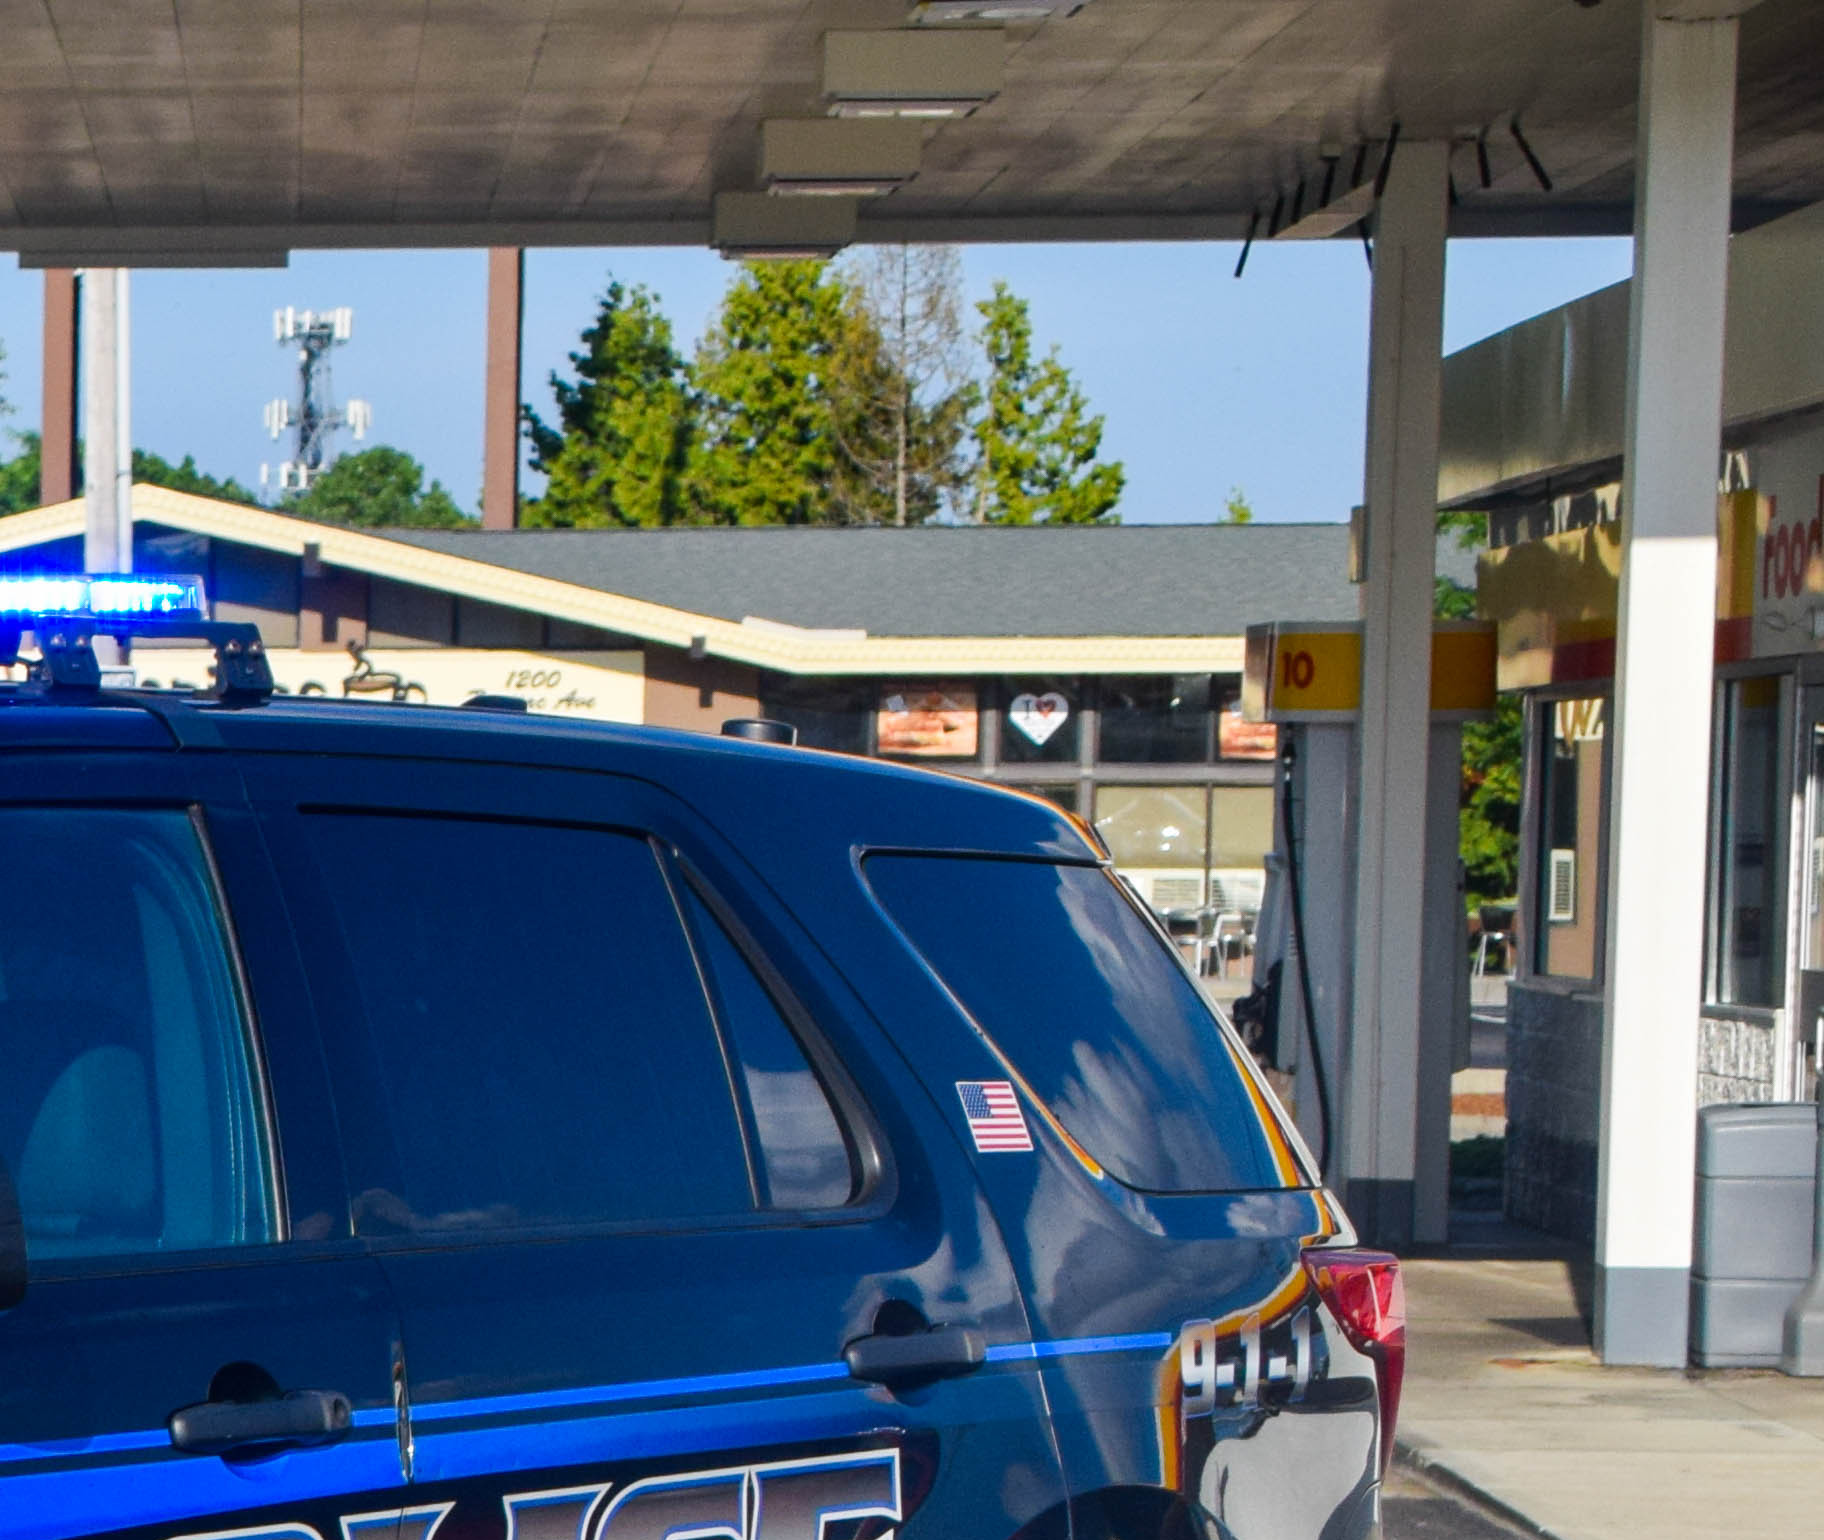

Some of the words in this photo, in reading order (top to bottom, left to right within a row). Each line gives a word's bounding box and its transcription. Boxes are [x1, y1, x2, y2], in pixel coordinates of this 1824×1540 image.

[504, 669, 562, 689] 1200
[1282, 650, 1315, 689] 10
[1181, 1305, 1310, 1419] 9-1-1
